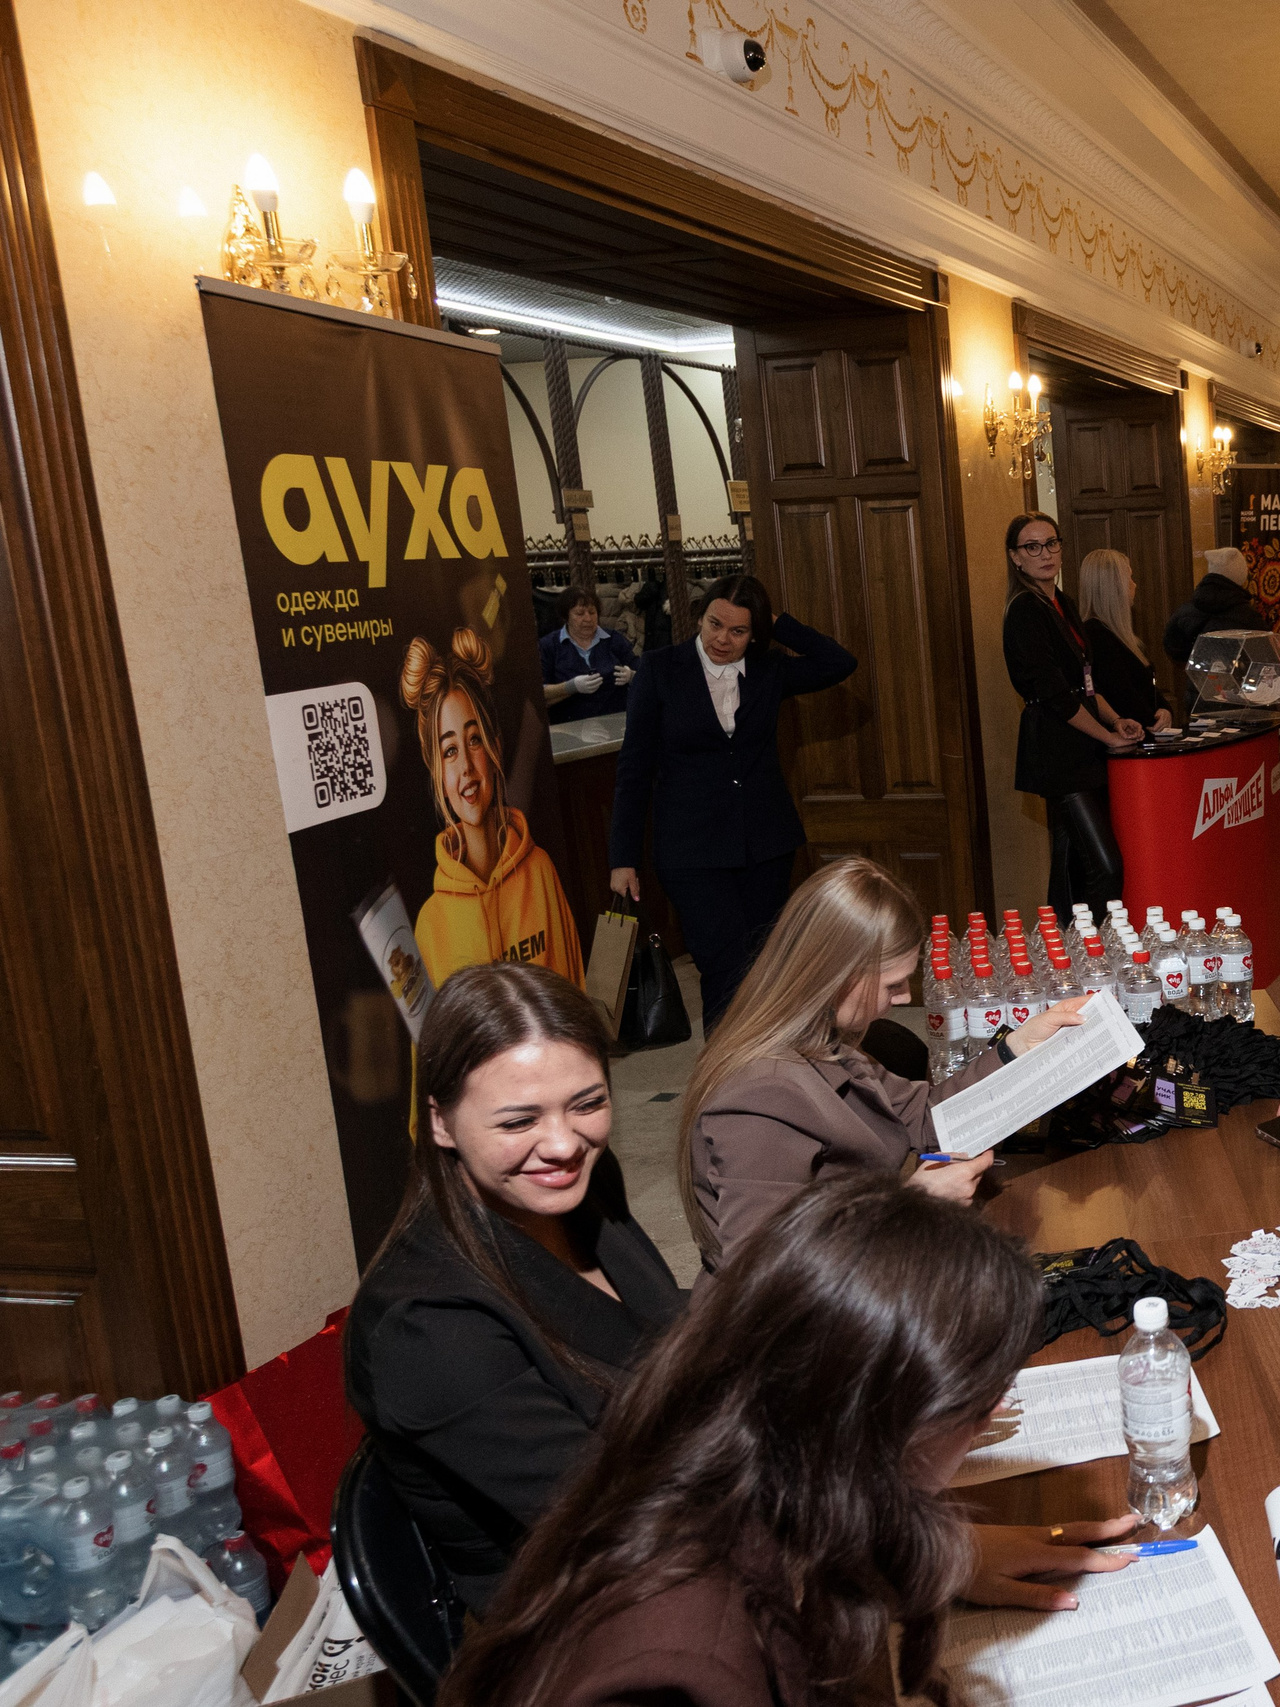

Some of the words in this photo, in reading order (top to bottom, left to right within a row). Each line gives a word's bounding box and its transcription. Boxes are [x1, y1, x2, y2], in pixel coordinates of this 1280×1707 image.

[260, 453, 510, 588] ауха
[276, 587, 360, 616] одежда
[282, 627, 295, 648] и
[300, 616, 394, 652] сувениры
[1201, 783, 1234, 825] АЛЬФА
[1227, 772, 1263, 825] БУДУЩЕЕ
[1156, 1085, 1176, 1095] УЧАС
